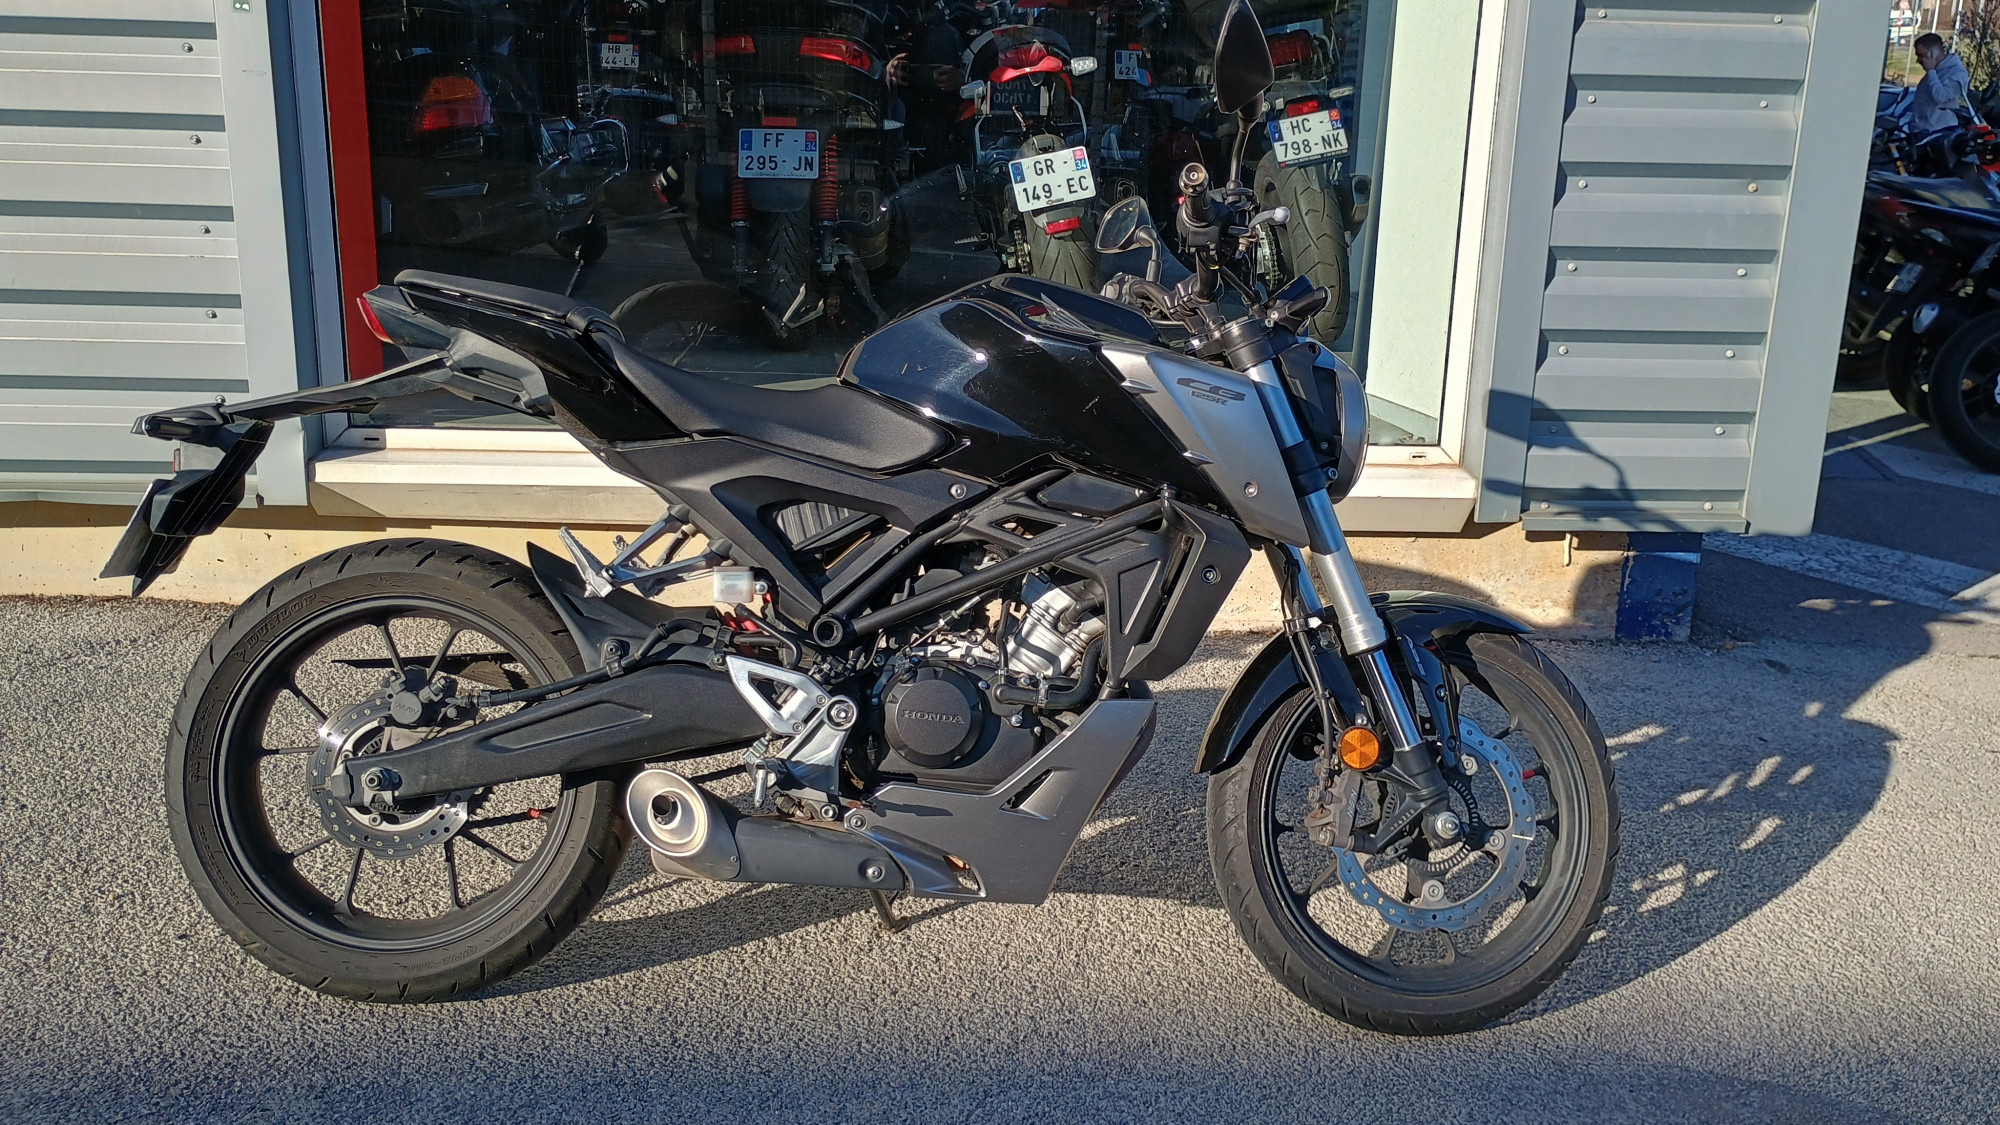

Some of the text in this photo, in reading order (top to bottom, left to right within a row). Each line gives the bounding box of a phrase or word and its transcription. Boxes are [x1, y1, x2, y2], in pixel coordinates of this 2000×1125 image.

[607, 45, 621, 54] HB
[1290, 118, 1312, 136] HC
[1332, 120, 1342, 129] 34
[763, 133, 785, 148] FF
[805, 142, 816, 151] 34
[1280, 132, 1343, 158] 798-NK
[1033, 158, 1056, 177] GR
[1075, 160, 1088, 170] 34
[1022, 175, 1089, 204] 149-EC
[1190, 391, 1229, 406] 125R
[244, 593, 317, 649] DUNLOP
[901, 709, 966, 724] HONDA
